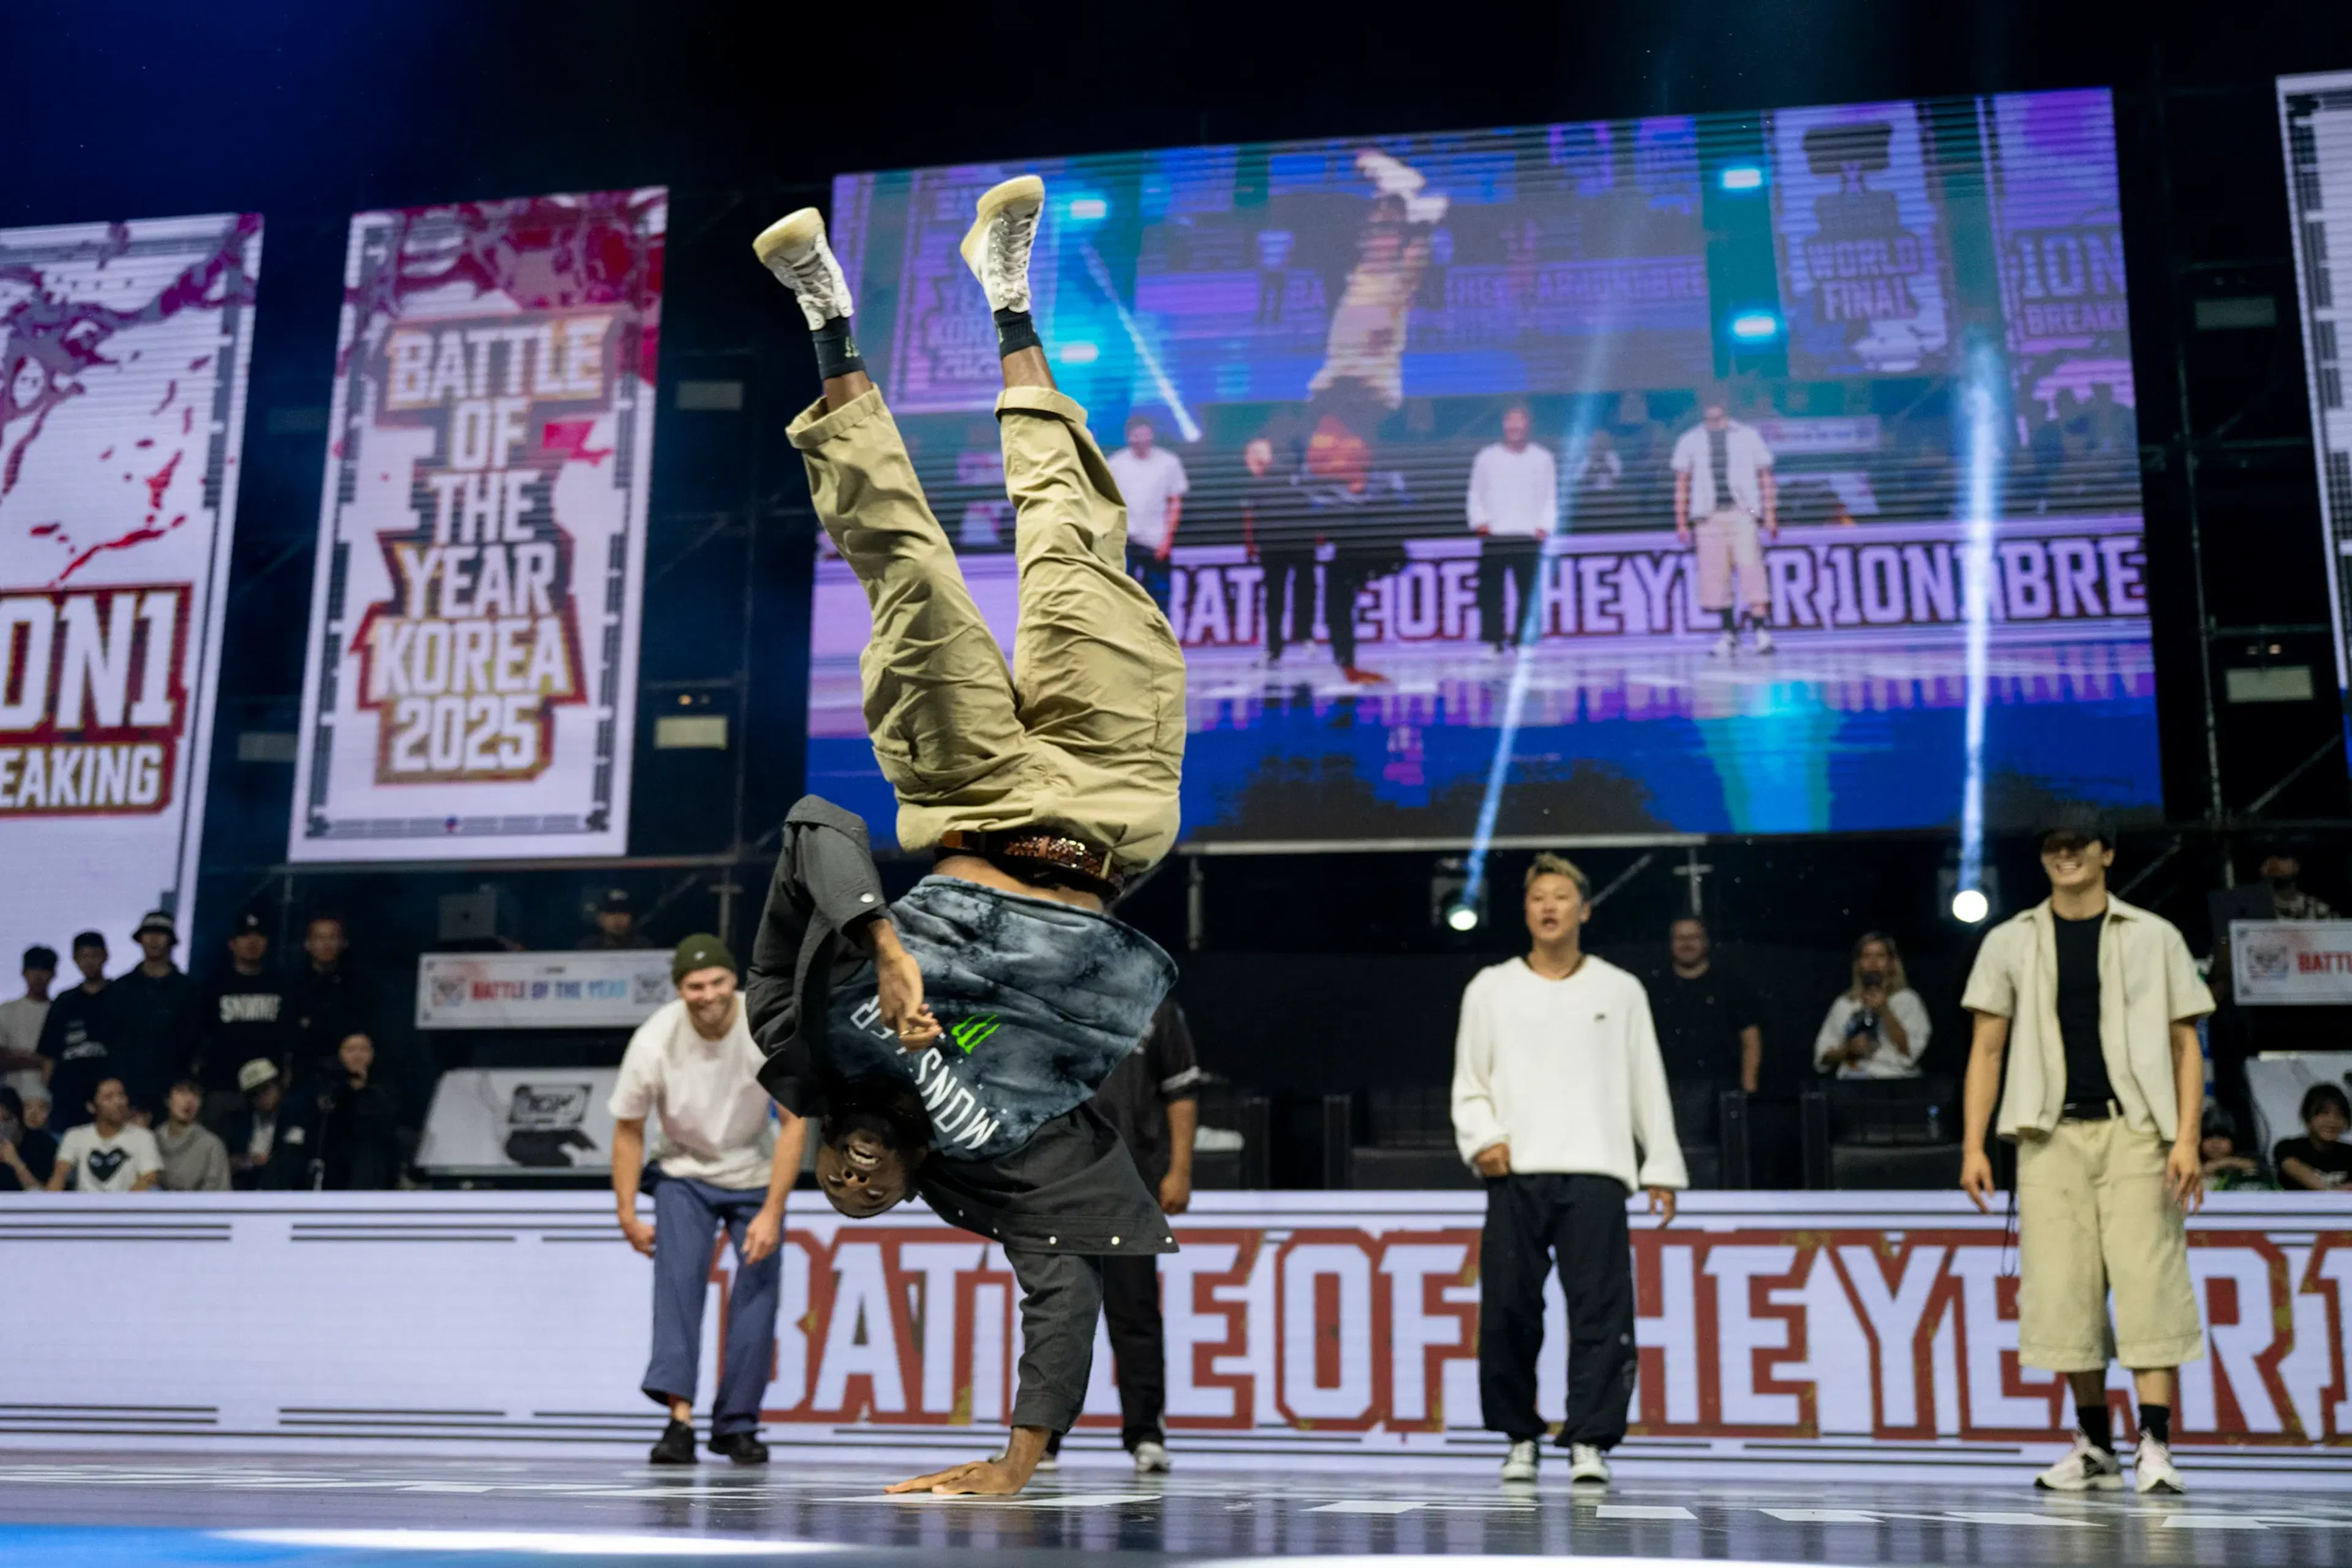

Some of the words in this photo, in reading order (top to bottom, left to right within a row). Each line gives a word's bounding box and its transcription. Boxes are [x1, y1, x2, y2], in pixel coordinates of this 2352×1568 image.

[1807, 237, 1918, 279] WORLD
[1822, 277, 1914, 321] FINAL
[390, 321, 604, 405] BATTLE
[452, 399, 530, 469] OF
[431, 469, 541, 544] THE
[401, 543, 556, 619] YEAR
[1401, 560, 1479, 638] OF
[375, 616, 568, 696] KOREA
[391, 695, 537, 772] 2025
[470, 980, 527, 1001] BATTLE
[530, 981, 551, 1000] OF
[554, 981, 582, 1000] THE
[587, 979, 627, 998] YEAR
[1283, 1244, 1470, 1420] OF
[1837, 1246, 2285, 1432] YER
